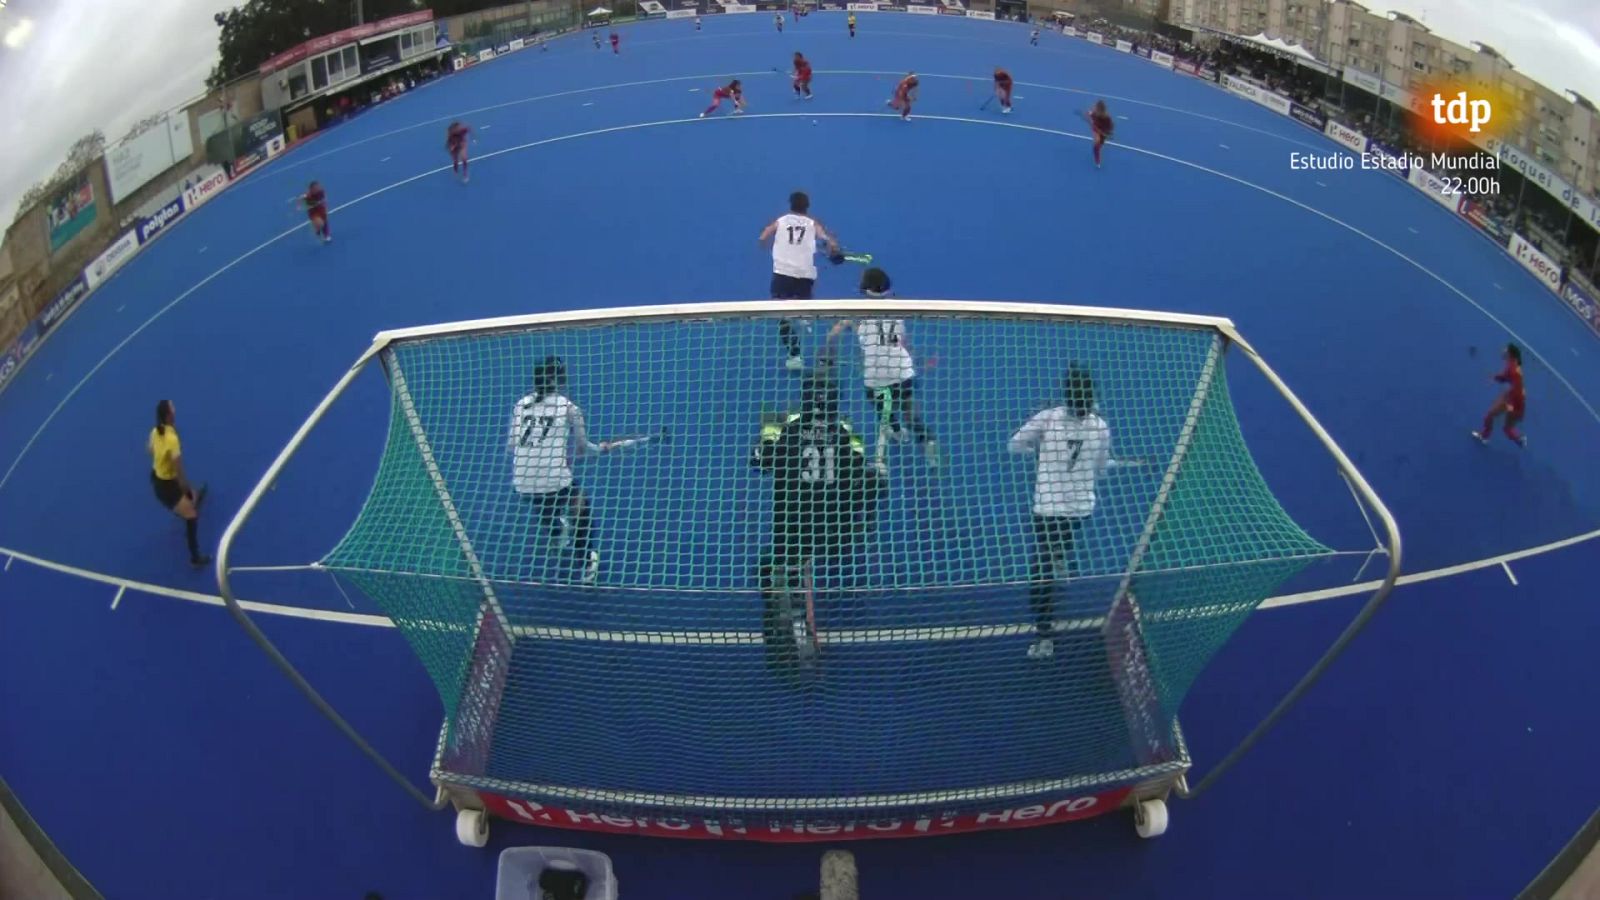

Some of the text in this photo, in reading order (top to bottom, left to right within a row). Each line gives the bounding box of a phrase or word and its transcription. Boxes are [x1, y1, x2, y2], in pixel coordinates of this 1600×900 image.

[1338, 130, 1360, 147] Hero
[199, 173, 224, 196] Hero
[1501, 144, 1551, 188] Hoquei
[1563, 188, 1580, 209] de
[786, 226, 806, 245] 17
[1529, 253, 1559, 284] Hero
[520, 415, 554, 447] 27
[801, 446, 835, 484] 31
[1066, 439, 1084, 472] 7
[566, 809, 691, 831] Hero
[977, 796, 1097, 824] Hero
